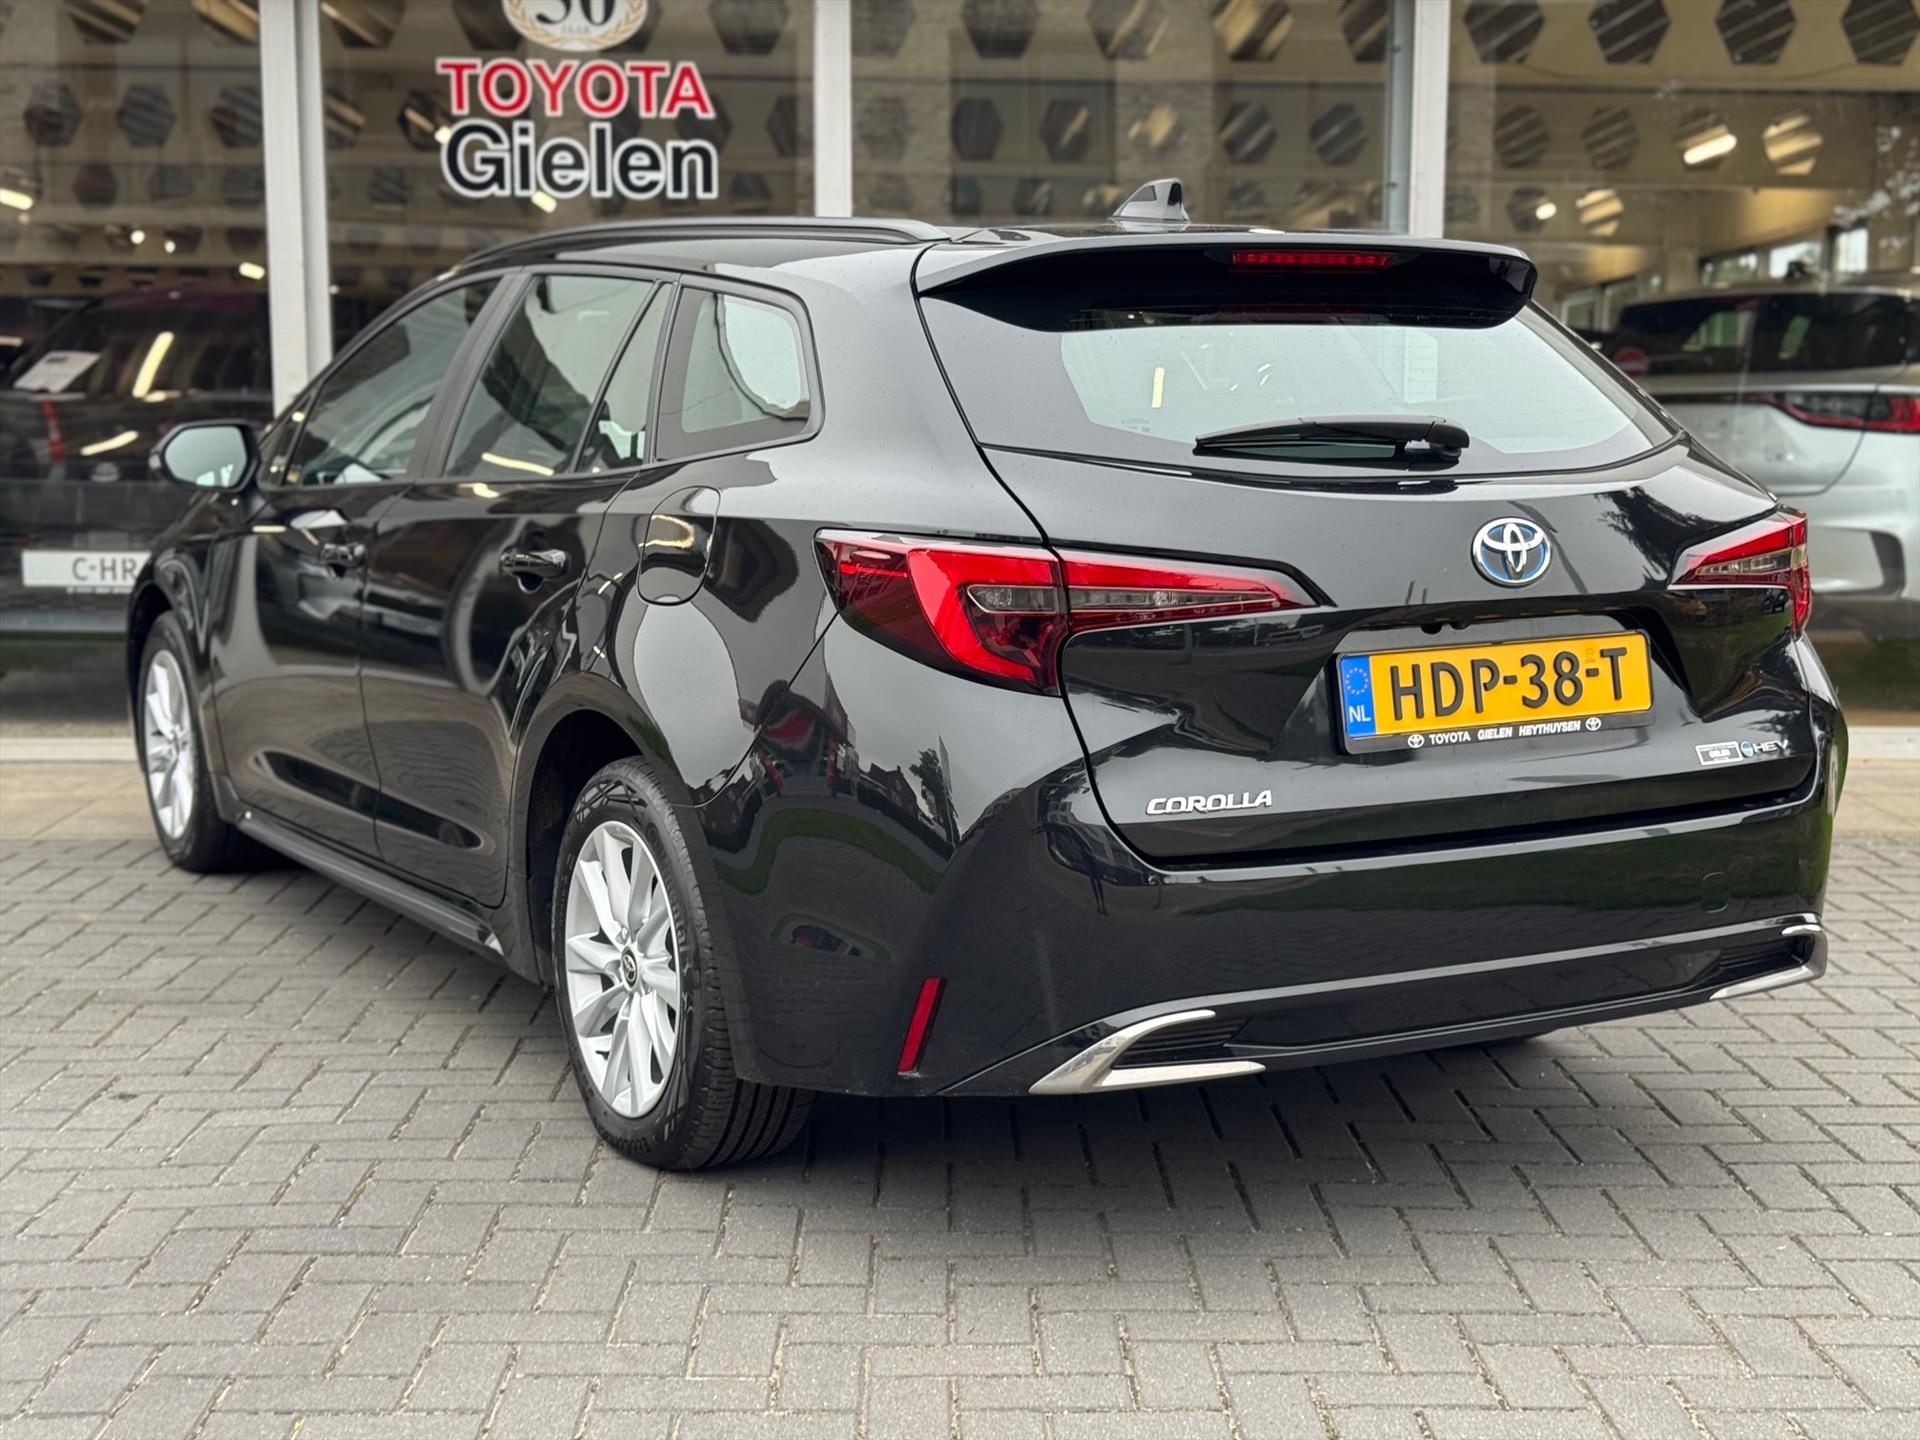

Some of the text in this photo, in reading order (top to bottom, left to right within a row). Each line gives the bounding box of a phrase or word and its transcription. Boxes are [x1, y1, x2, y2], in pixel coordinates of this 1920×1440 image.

[436, 58, 716, 118] TOYOTA
[440, 119, 719, 199] Gielen
[72, 556, 138, 582] C-HR
[1389, 646, 1627, 721] HDP-38-T
[1348, 705, 1372, 723] NL
[1429, 720, 1581, 746] TOYOTA GIELEN HEYTHUYSEN
[1145, 789, 1273, 815] COROLLA
